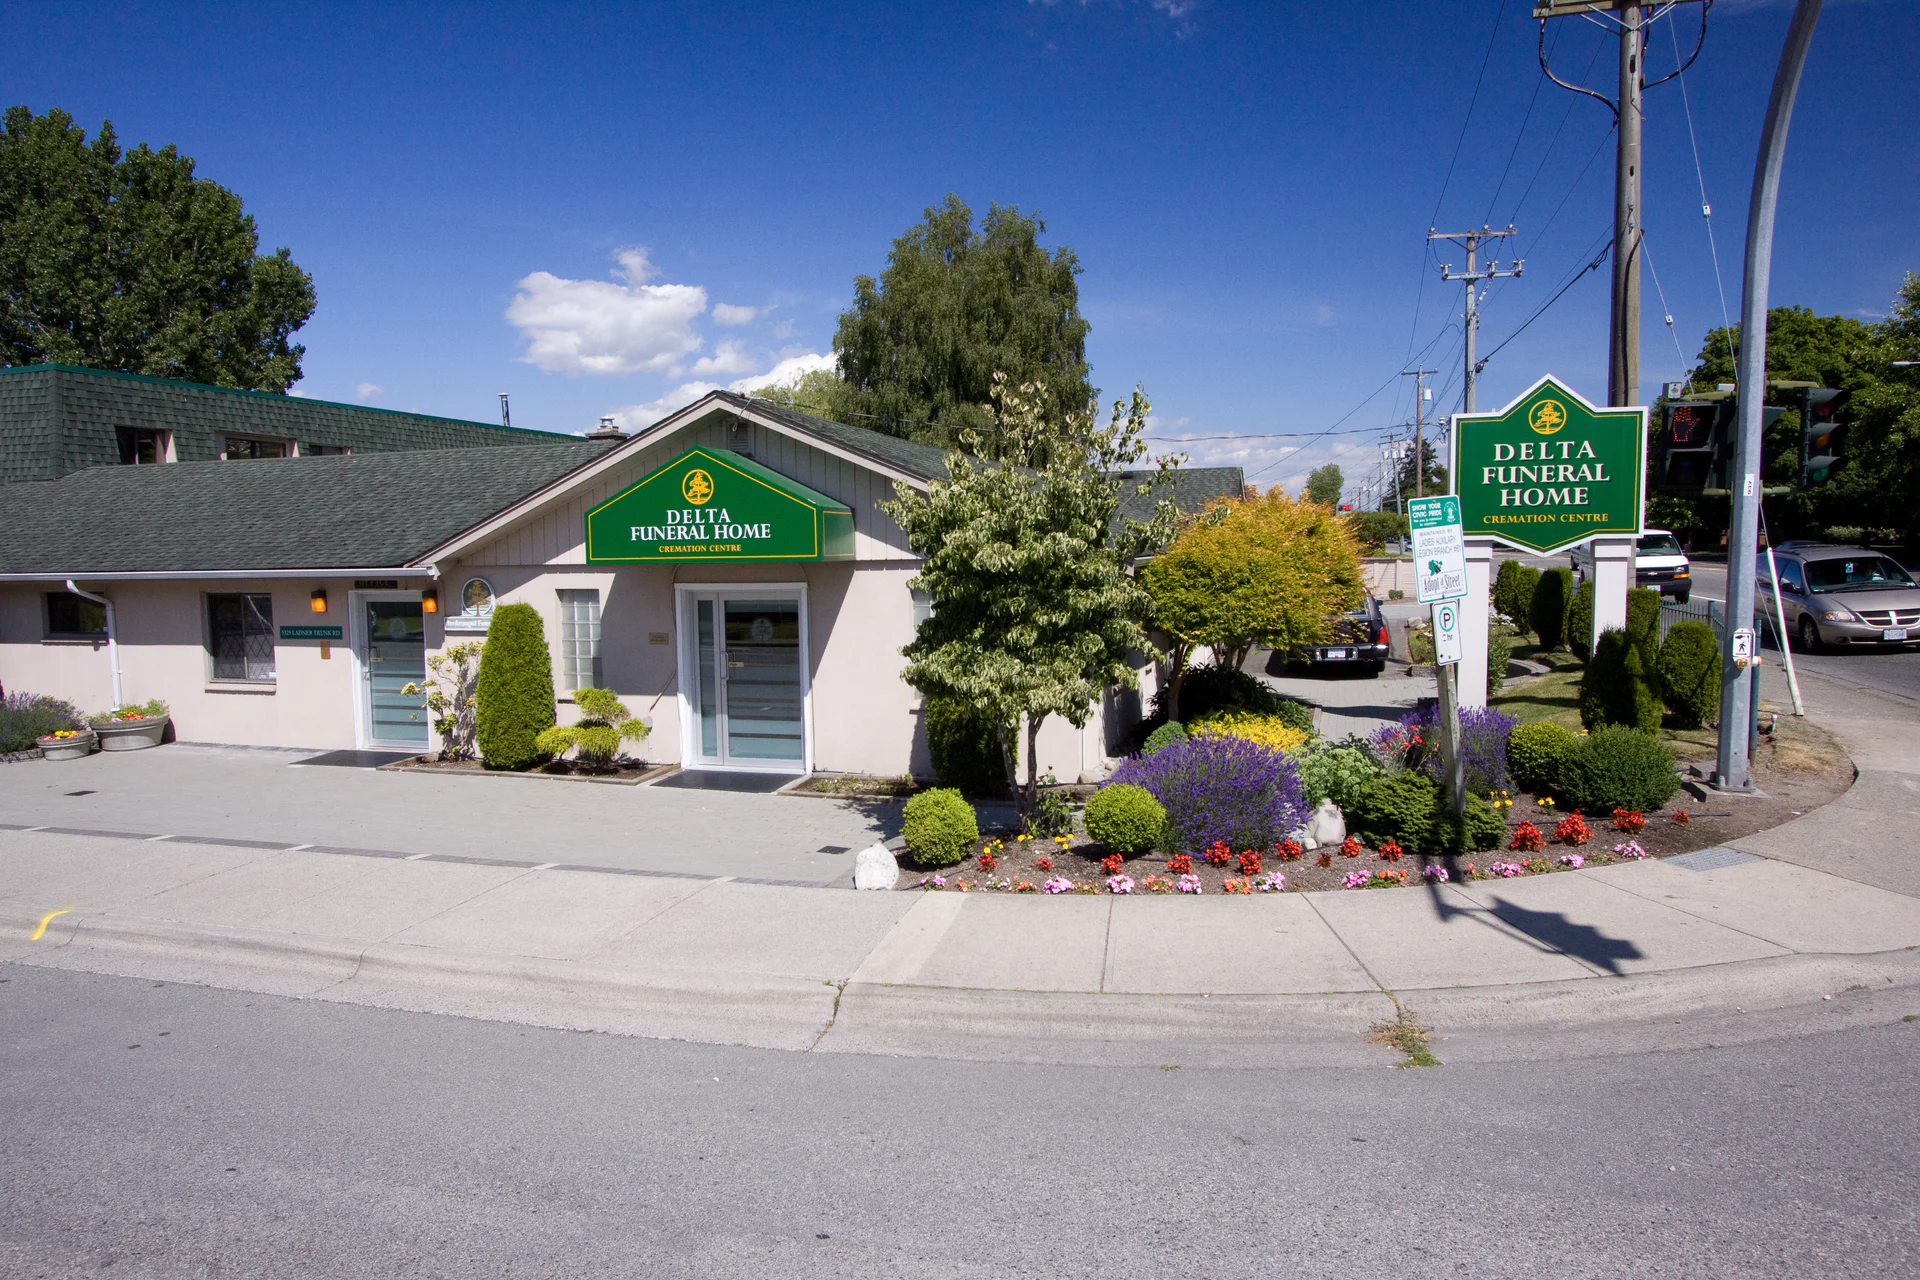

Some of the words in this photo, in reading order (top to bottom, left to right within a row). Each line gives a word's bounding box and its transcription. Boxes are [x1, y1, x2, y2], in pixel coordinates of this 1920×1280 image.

[1493, 440, 1597, 461] DELTA
[1481, 463, 1610, 485] FUNERAL
[1500, 487, 1589, 507] HOME
[666, 508, 731, 525] DELTA
[1428, 509, 1442, 517] PRIDE
[1483, 514, 1556, 524] CREMATION
[1560, 513, 1609, 522] CENTRE
[630, 524, 709, 542] FUNERAL
[713, 523, 771, 540] HOME
[1419, 529, 1446, 537] MAINTAINED
[658, 545, 706, 553] CREMATION
[709, 544, 742, 552] CENTRE
[1434, 546, 1452, 556] BRANCH
[1444, 574, 1461, 590] Street
[1443, 612, 1451, 628] P
